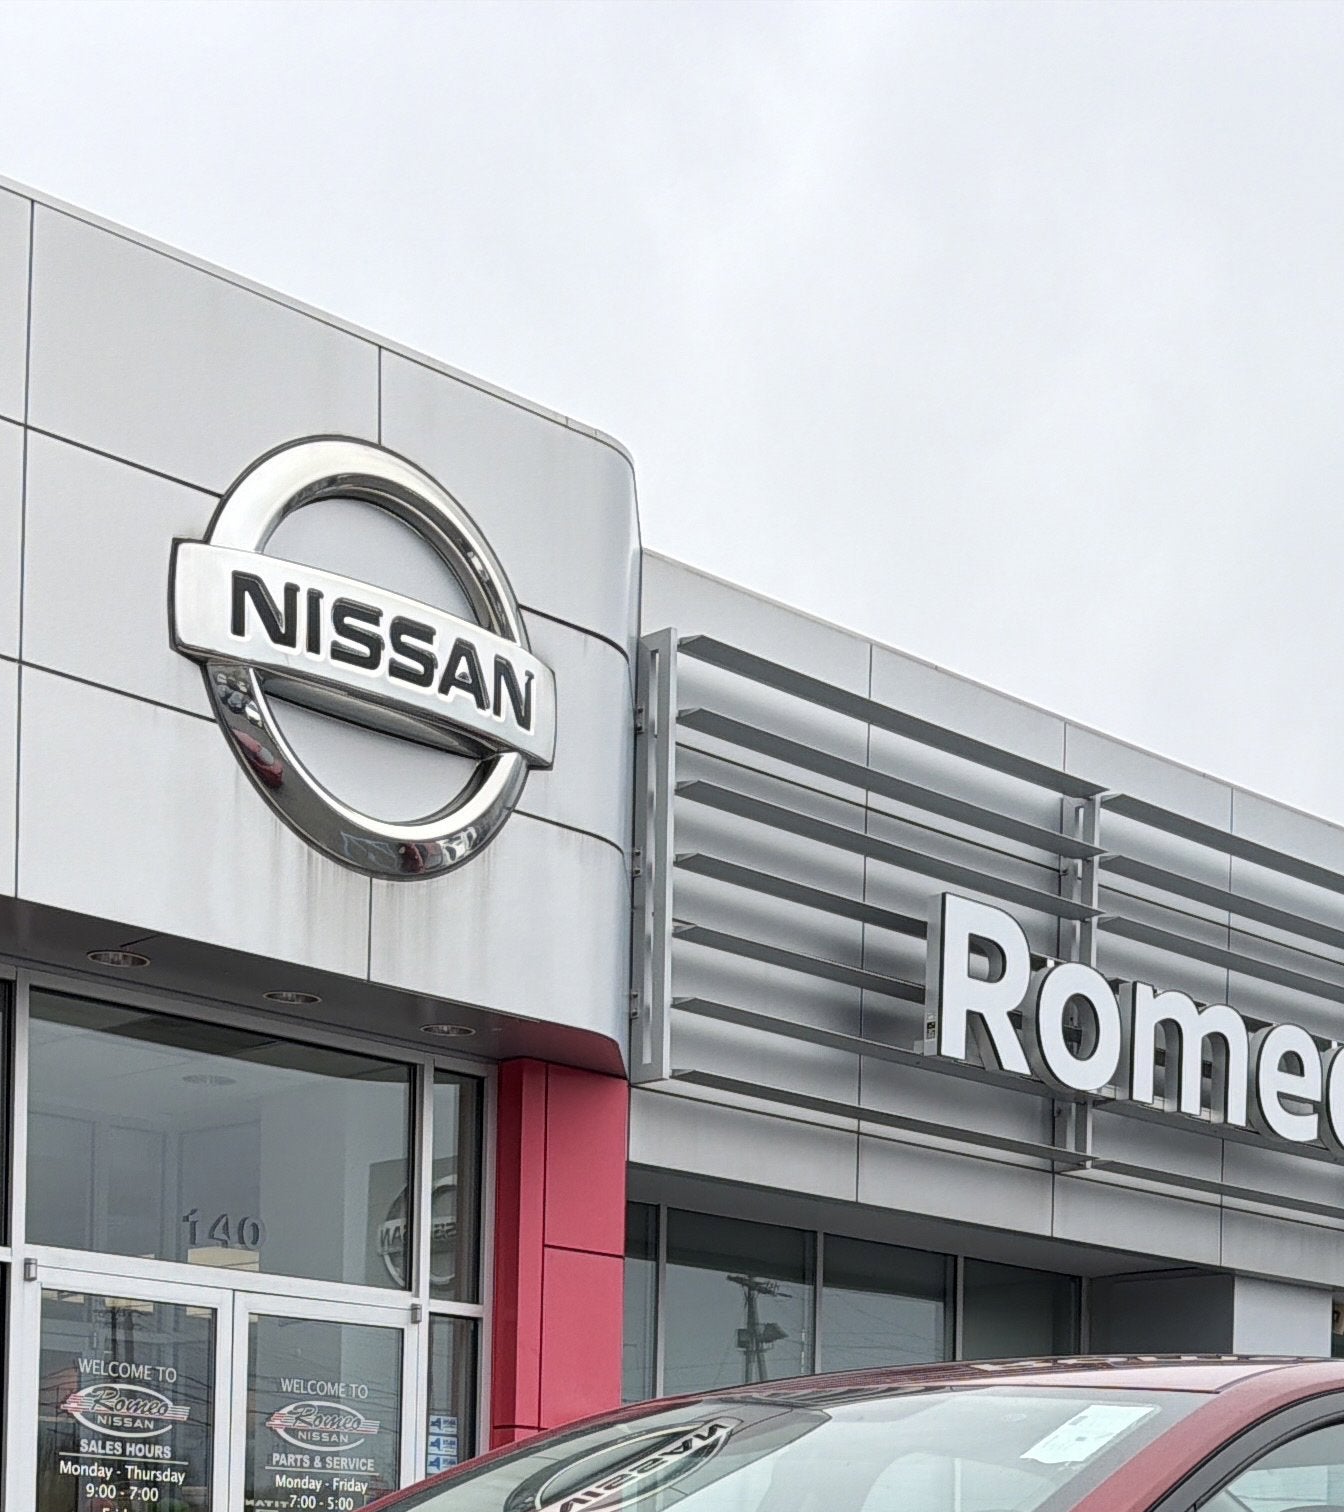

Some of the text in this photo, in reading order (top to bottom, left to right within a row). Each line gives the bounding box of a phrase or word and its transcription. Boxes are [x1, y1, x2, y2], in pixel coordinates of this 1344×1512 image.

[230, 569, 536, 732] NISSAN
[182, 1208, 264, 1251] 140
[78, 1358, 177, 1383] WELCOME TO
[280, 1377, 369, 1399] WELCOME TO
[91, 1386, 169, 1416] Romeo
[97, 1415, 155, 1430] NISSAN
[287, 1404, 362, 1431] Romeo
[297, 1431, 349, 1443] NISSAN
[79, 1438, 172, 1459] SALES HOURS
[272, 1452, 375, 1471] PARTS & SERVICE
[59, 1460, 114, 1481] Monday
[124, 1464, 186, 1486] Thursday
[85, 1482, 117, 1499] 9:00
[129, 1485, 159, 1502] 7:00
[275, 1474, 323, 1493] Monday
[332, 1477, 369, 1495] Friday
[289, 1494, 317, 1509] 7:00
[327, 1496, 354, 1511] 5:00
